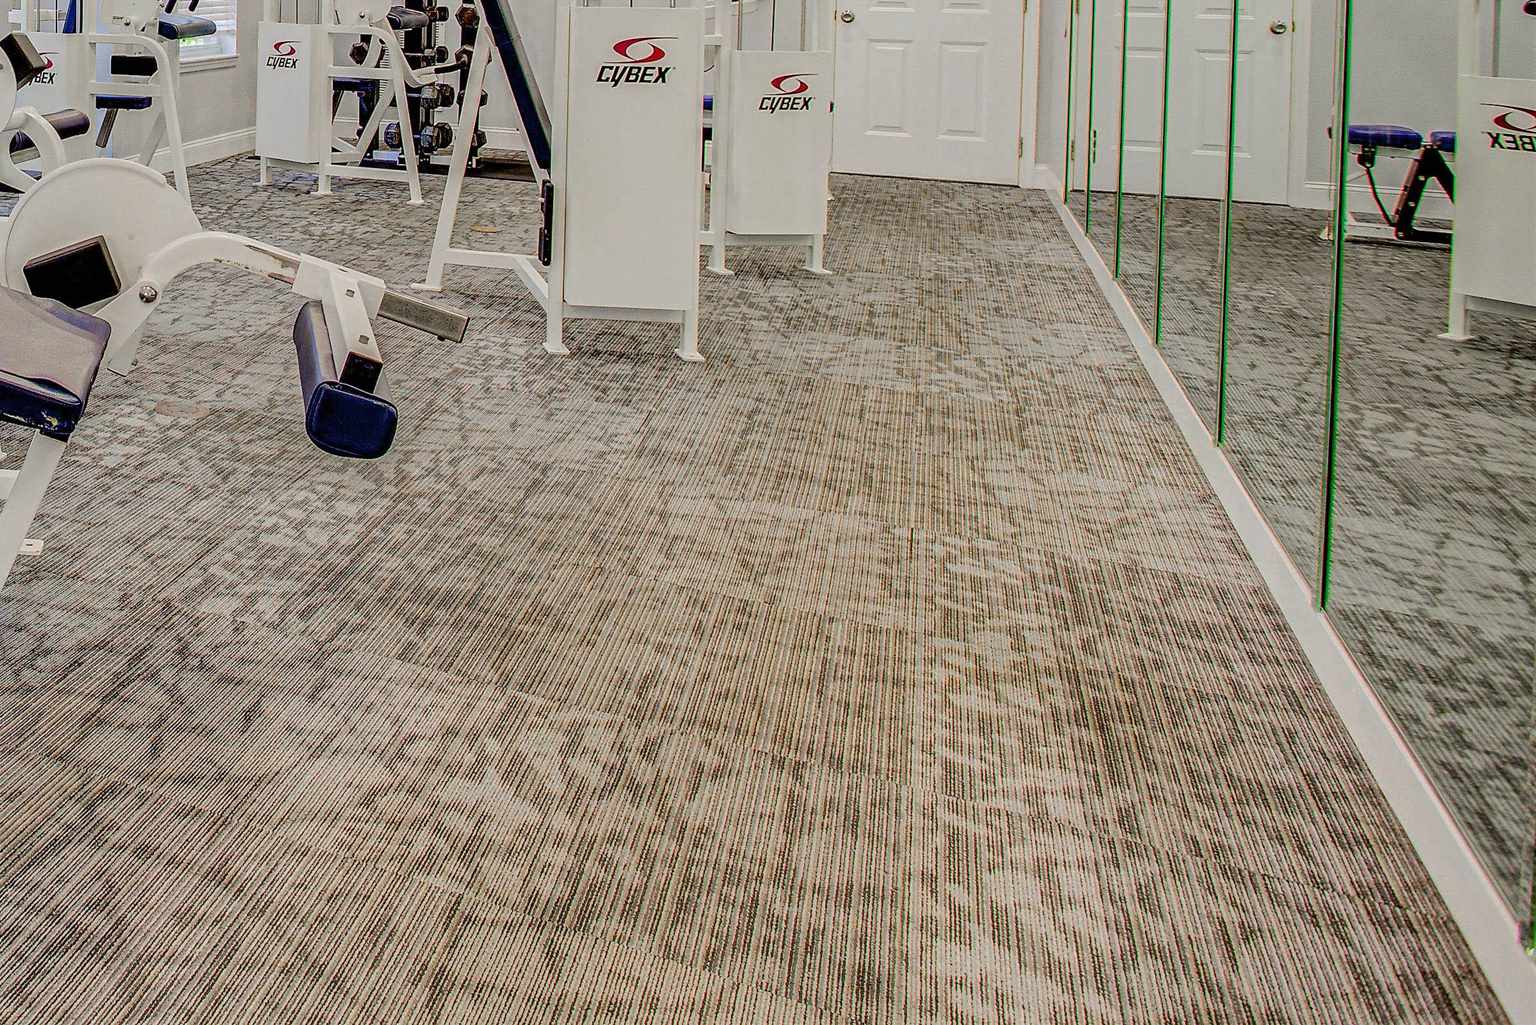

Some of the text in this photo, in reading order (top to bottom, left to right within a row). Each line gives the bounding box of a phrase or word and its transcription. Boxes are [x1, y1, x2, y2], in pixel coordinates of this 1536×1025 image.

[266, 56, 298, 70] CYBEX
[596, 65, 670, 88] CYBEX
[758, 94, 811, 114] CYBEX
